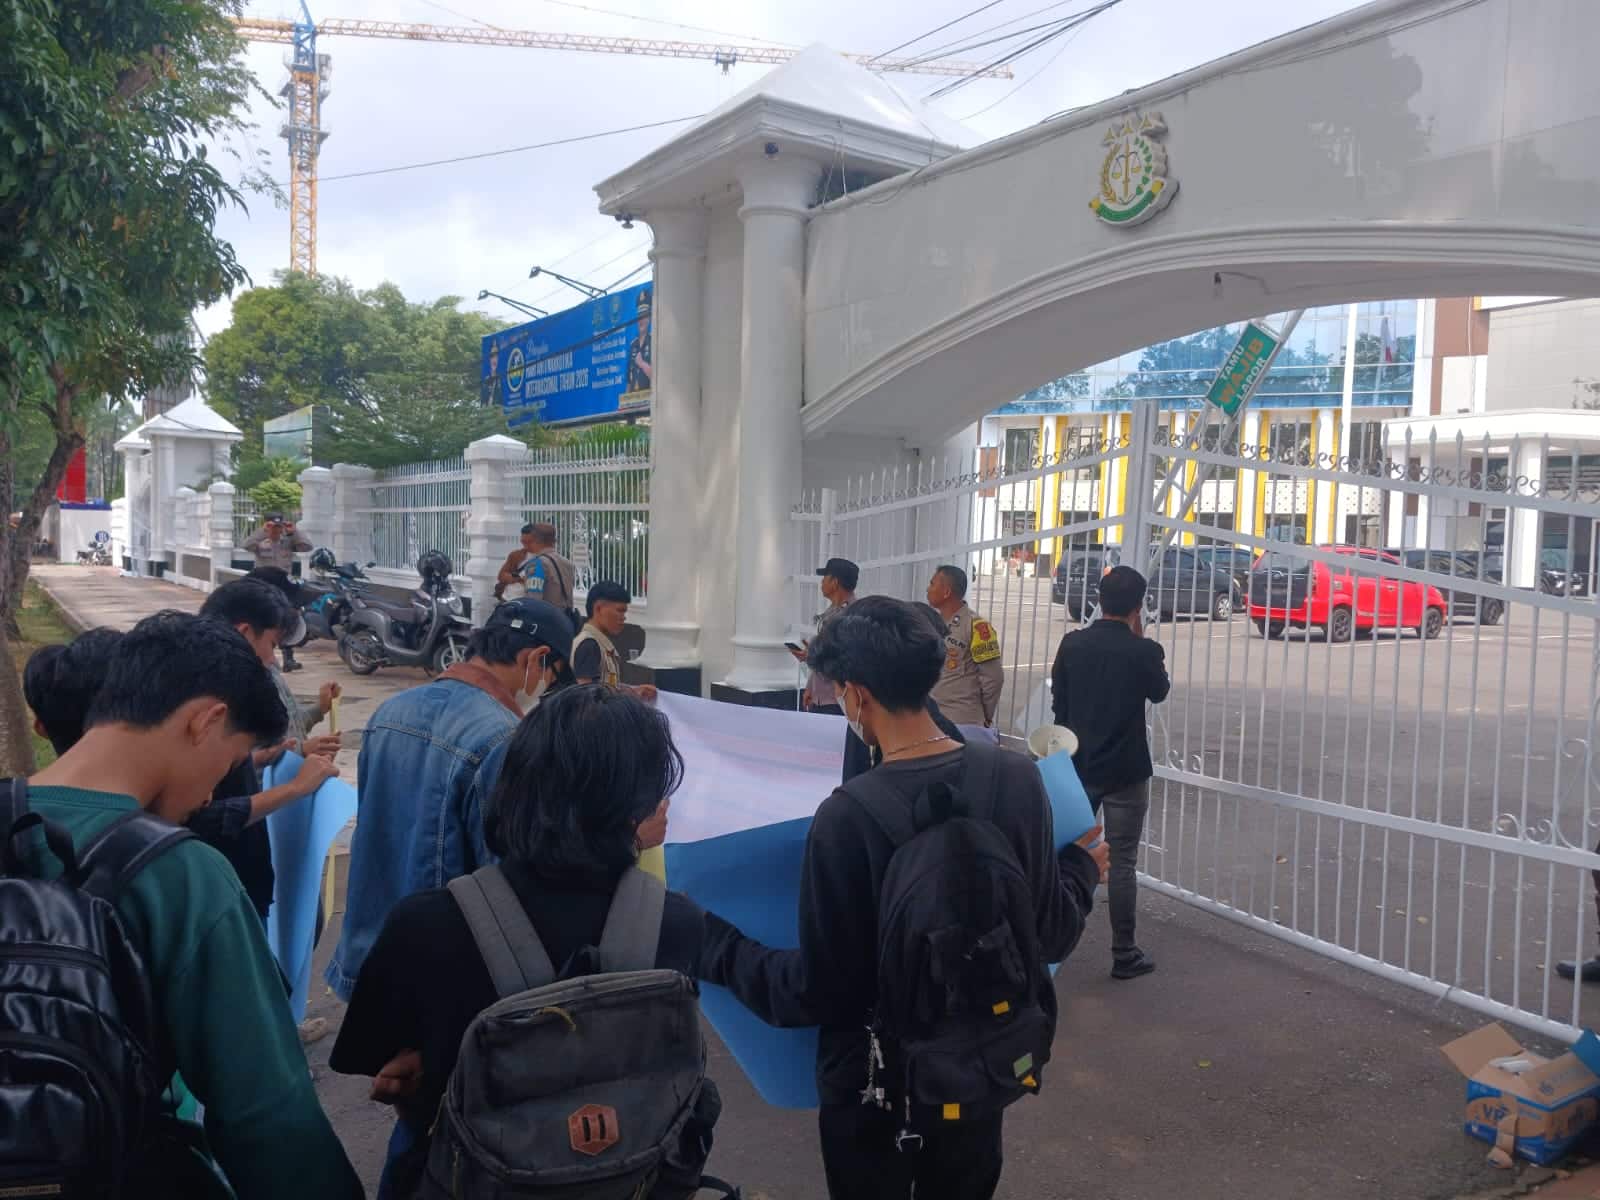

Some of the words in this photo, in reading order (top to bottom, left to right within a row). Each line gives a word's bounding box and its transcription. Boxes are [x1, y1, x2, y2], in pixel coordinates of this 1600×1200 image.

[1218, 338, 1264, 403] WAJIB
[1221, 345, 1245, 379] TAMU
[1236, 357, 1266, 400] LAPOR
